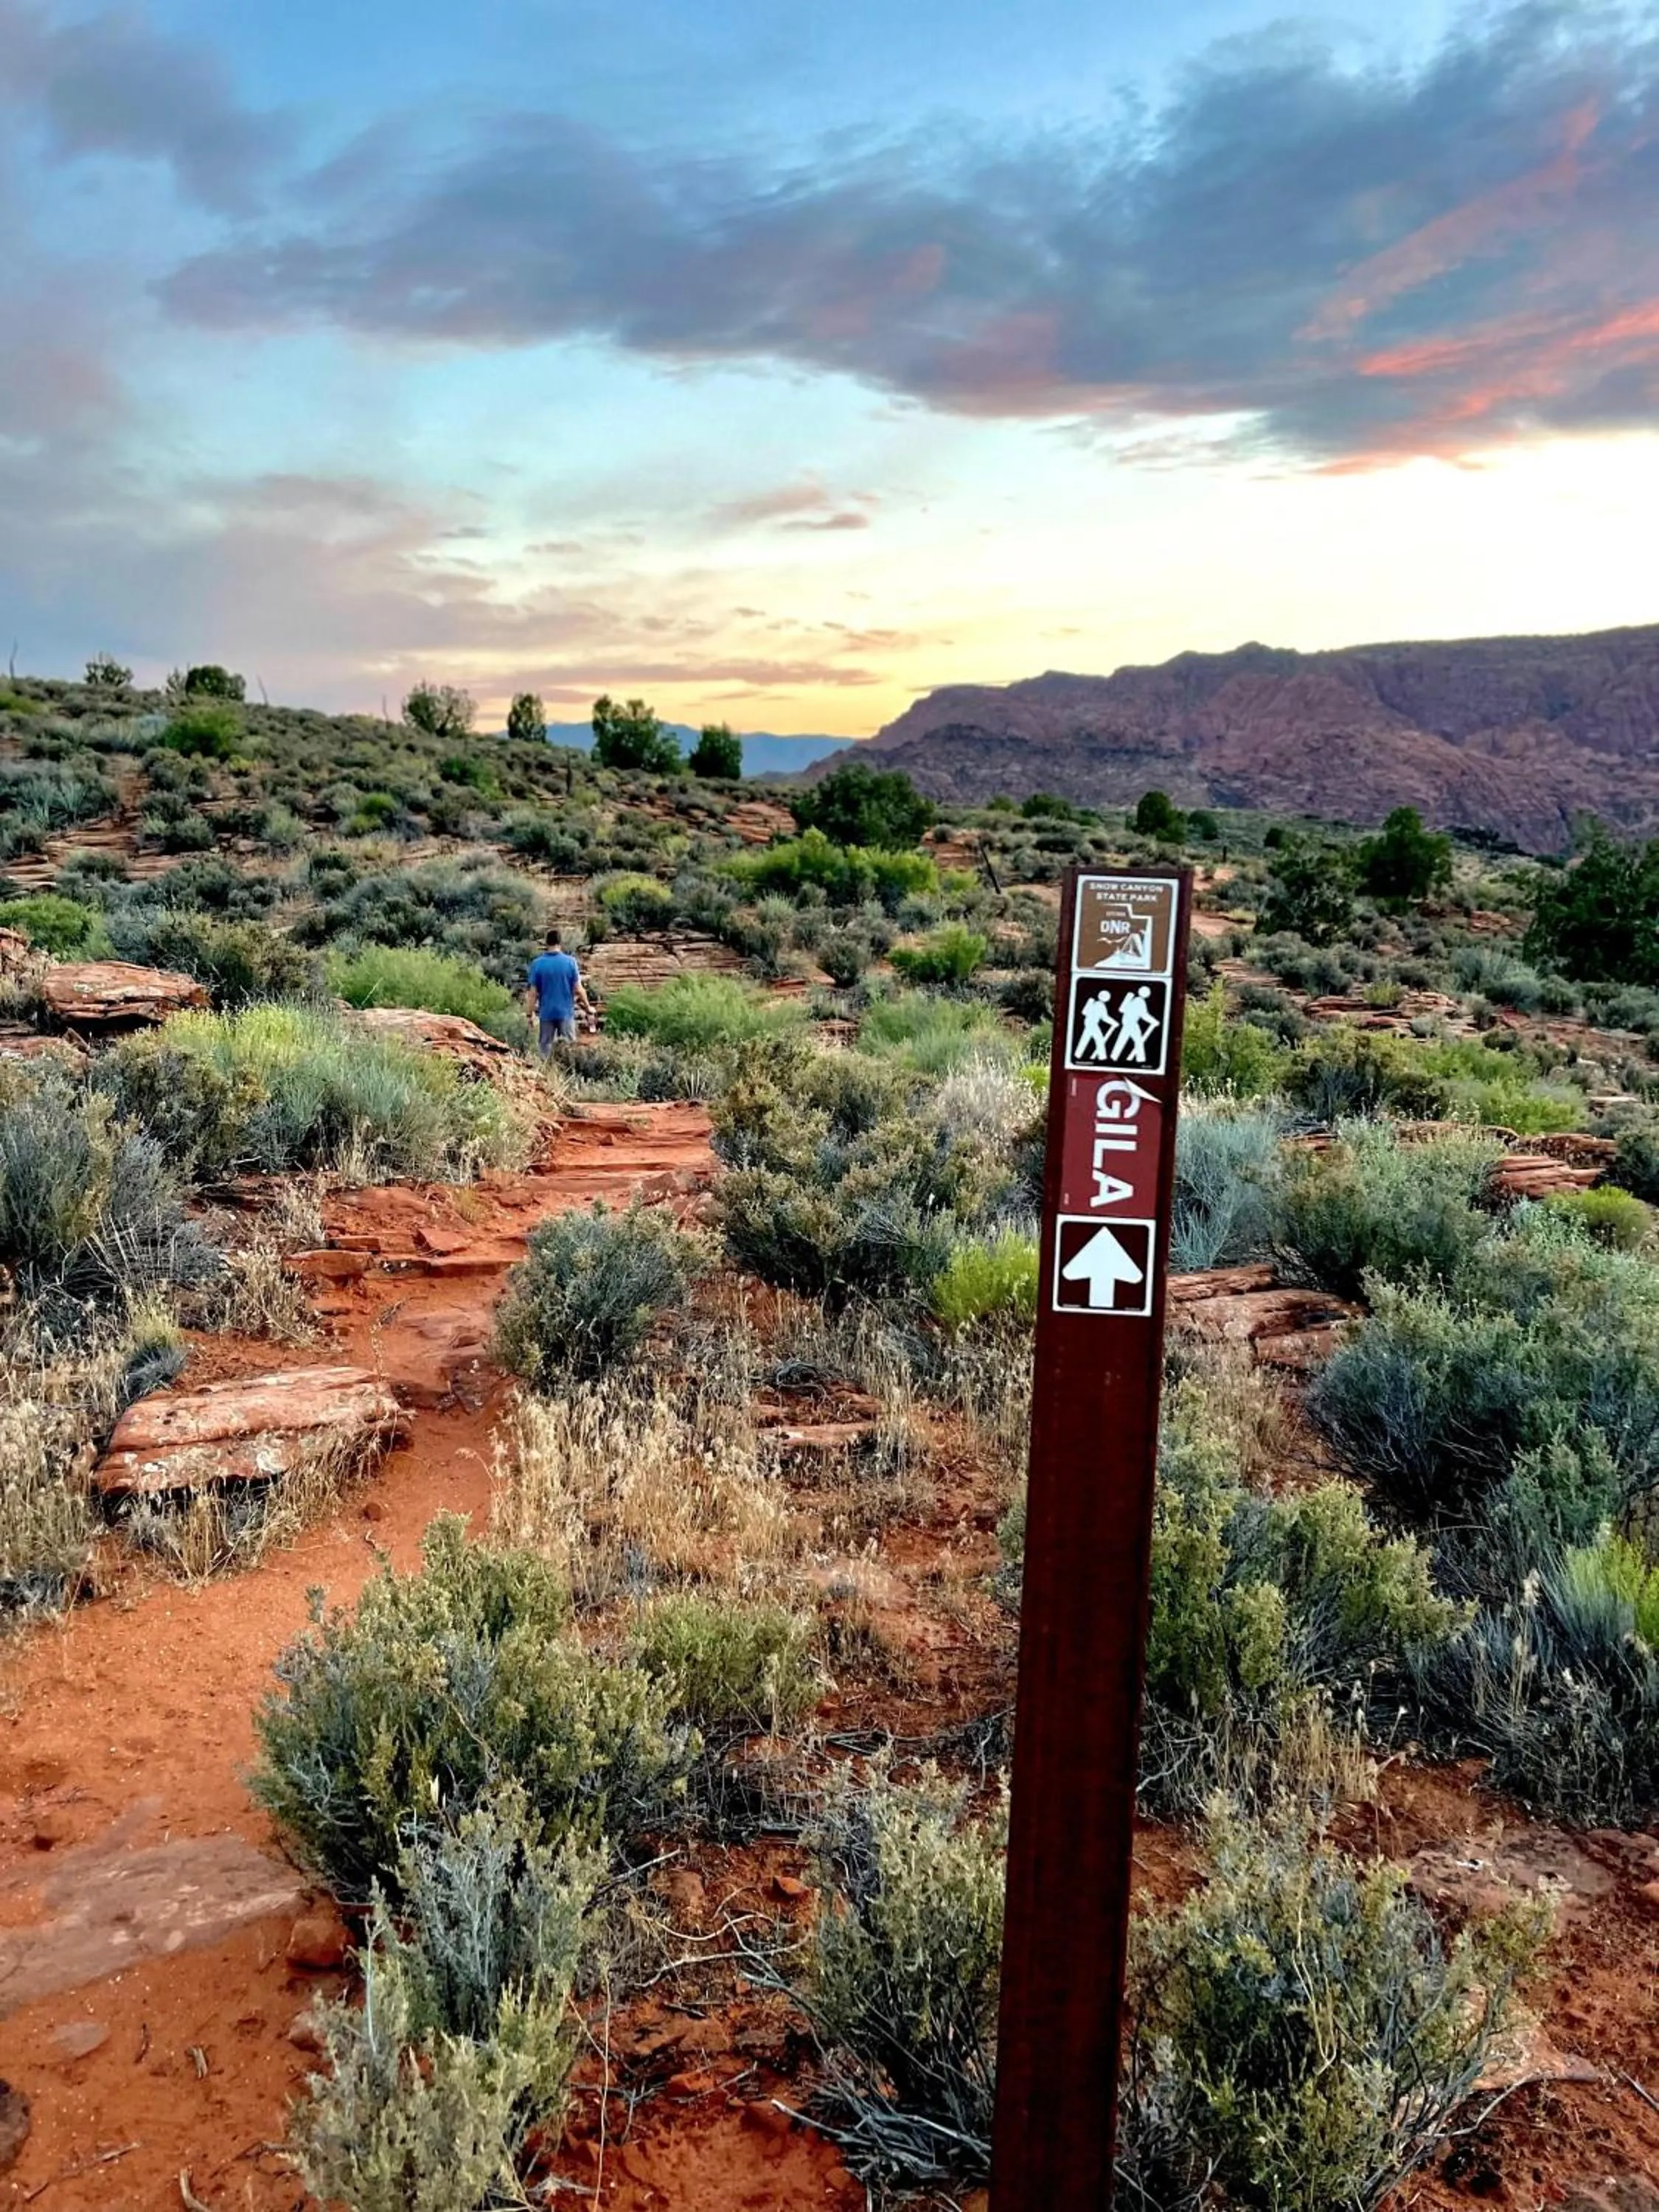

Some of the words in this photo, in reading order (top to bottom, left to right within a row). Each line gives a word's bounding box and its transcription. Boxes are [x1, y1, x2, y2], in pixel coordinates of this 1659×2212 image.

[1089, 883, 1118, 891] SNOW
[1121, 883, 1164, 892] CANYON
[1130, 894, 1157, 902] PARK
[1100, 920, 1130, 933] DNR
[1090, 1080, 1141, 1207] GILA
